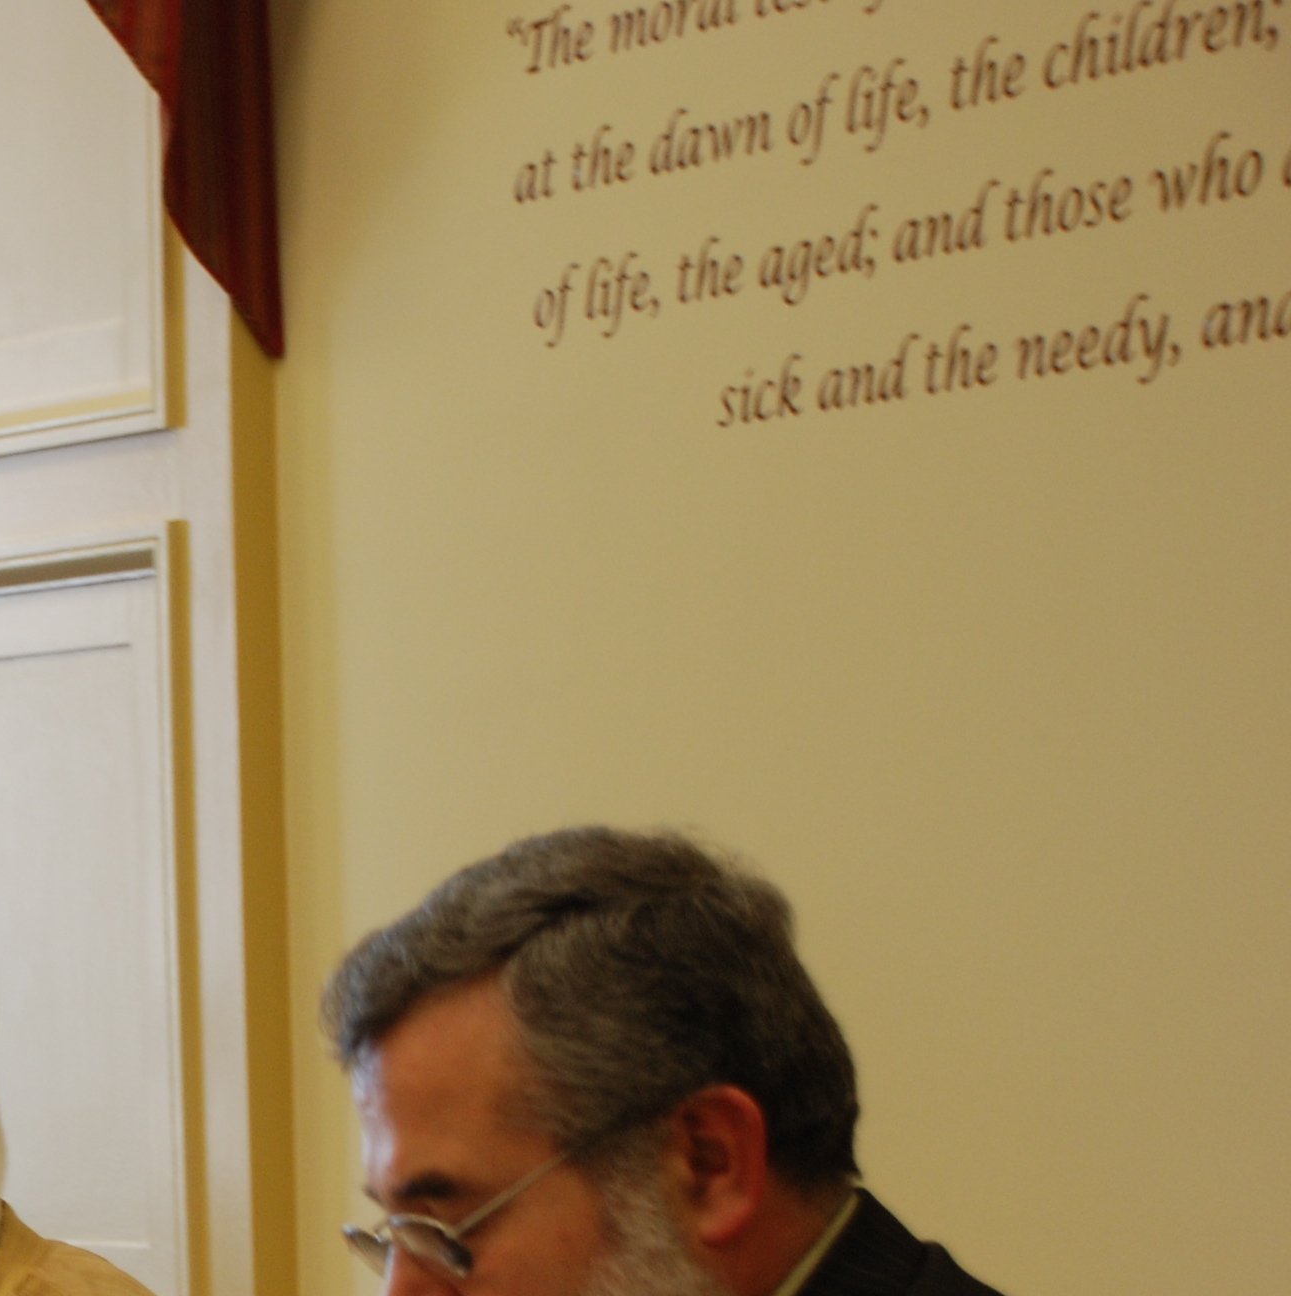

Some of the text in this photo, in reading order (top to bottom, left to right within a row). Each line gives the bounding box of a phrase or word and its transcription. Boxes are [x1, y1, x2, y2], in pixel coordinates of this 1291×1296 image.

[514, 150, 556, 203] at
[571, 124, 635, 190] the
[649, 108, 773, 176] dawn
[788, 72, 840, 166] of
[845, 58, 929, 152] life,
[949, 36, 1026, 110] the
[533, 262, 580, 347] of
[585, 252, 660, 338] life,
[676, 236, 744, 303] the
[759, 204, 878, 306] aged;
[892, 179, 1001, 263] and
[1005, 168, 1133, 242] those
[1149, 131, 1264, 213] who
[717, 353, 803, 428] sick
[817, 333, 921, 411] and
[925, 324, 999, 394] the
[1017, 293, 1181, 384] needy,
